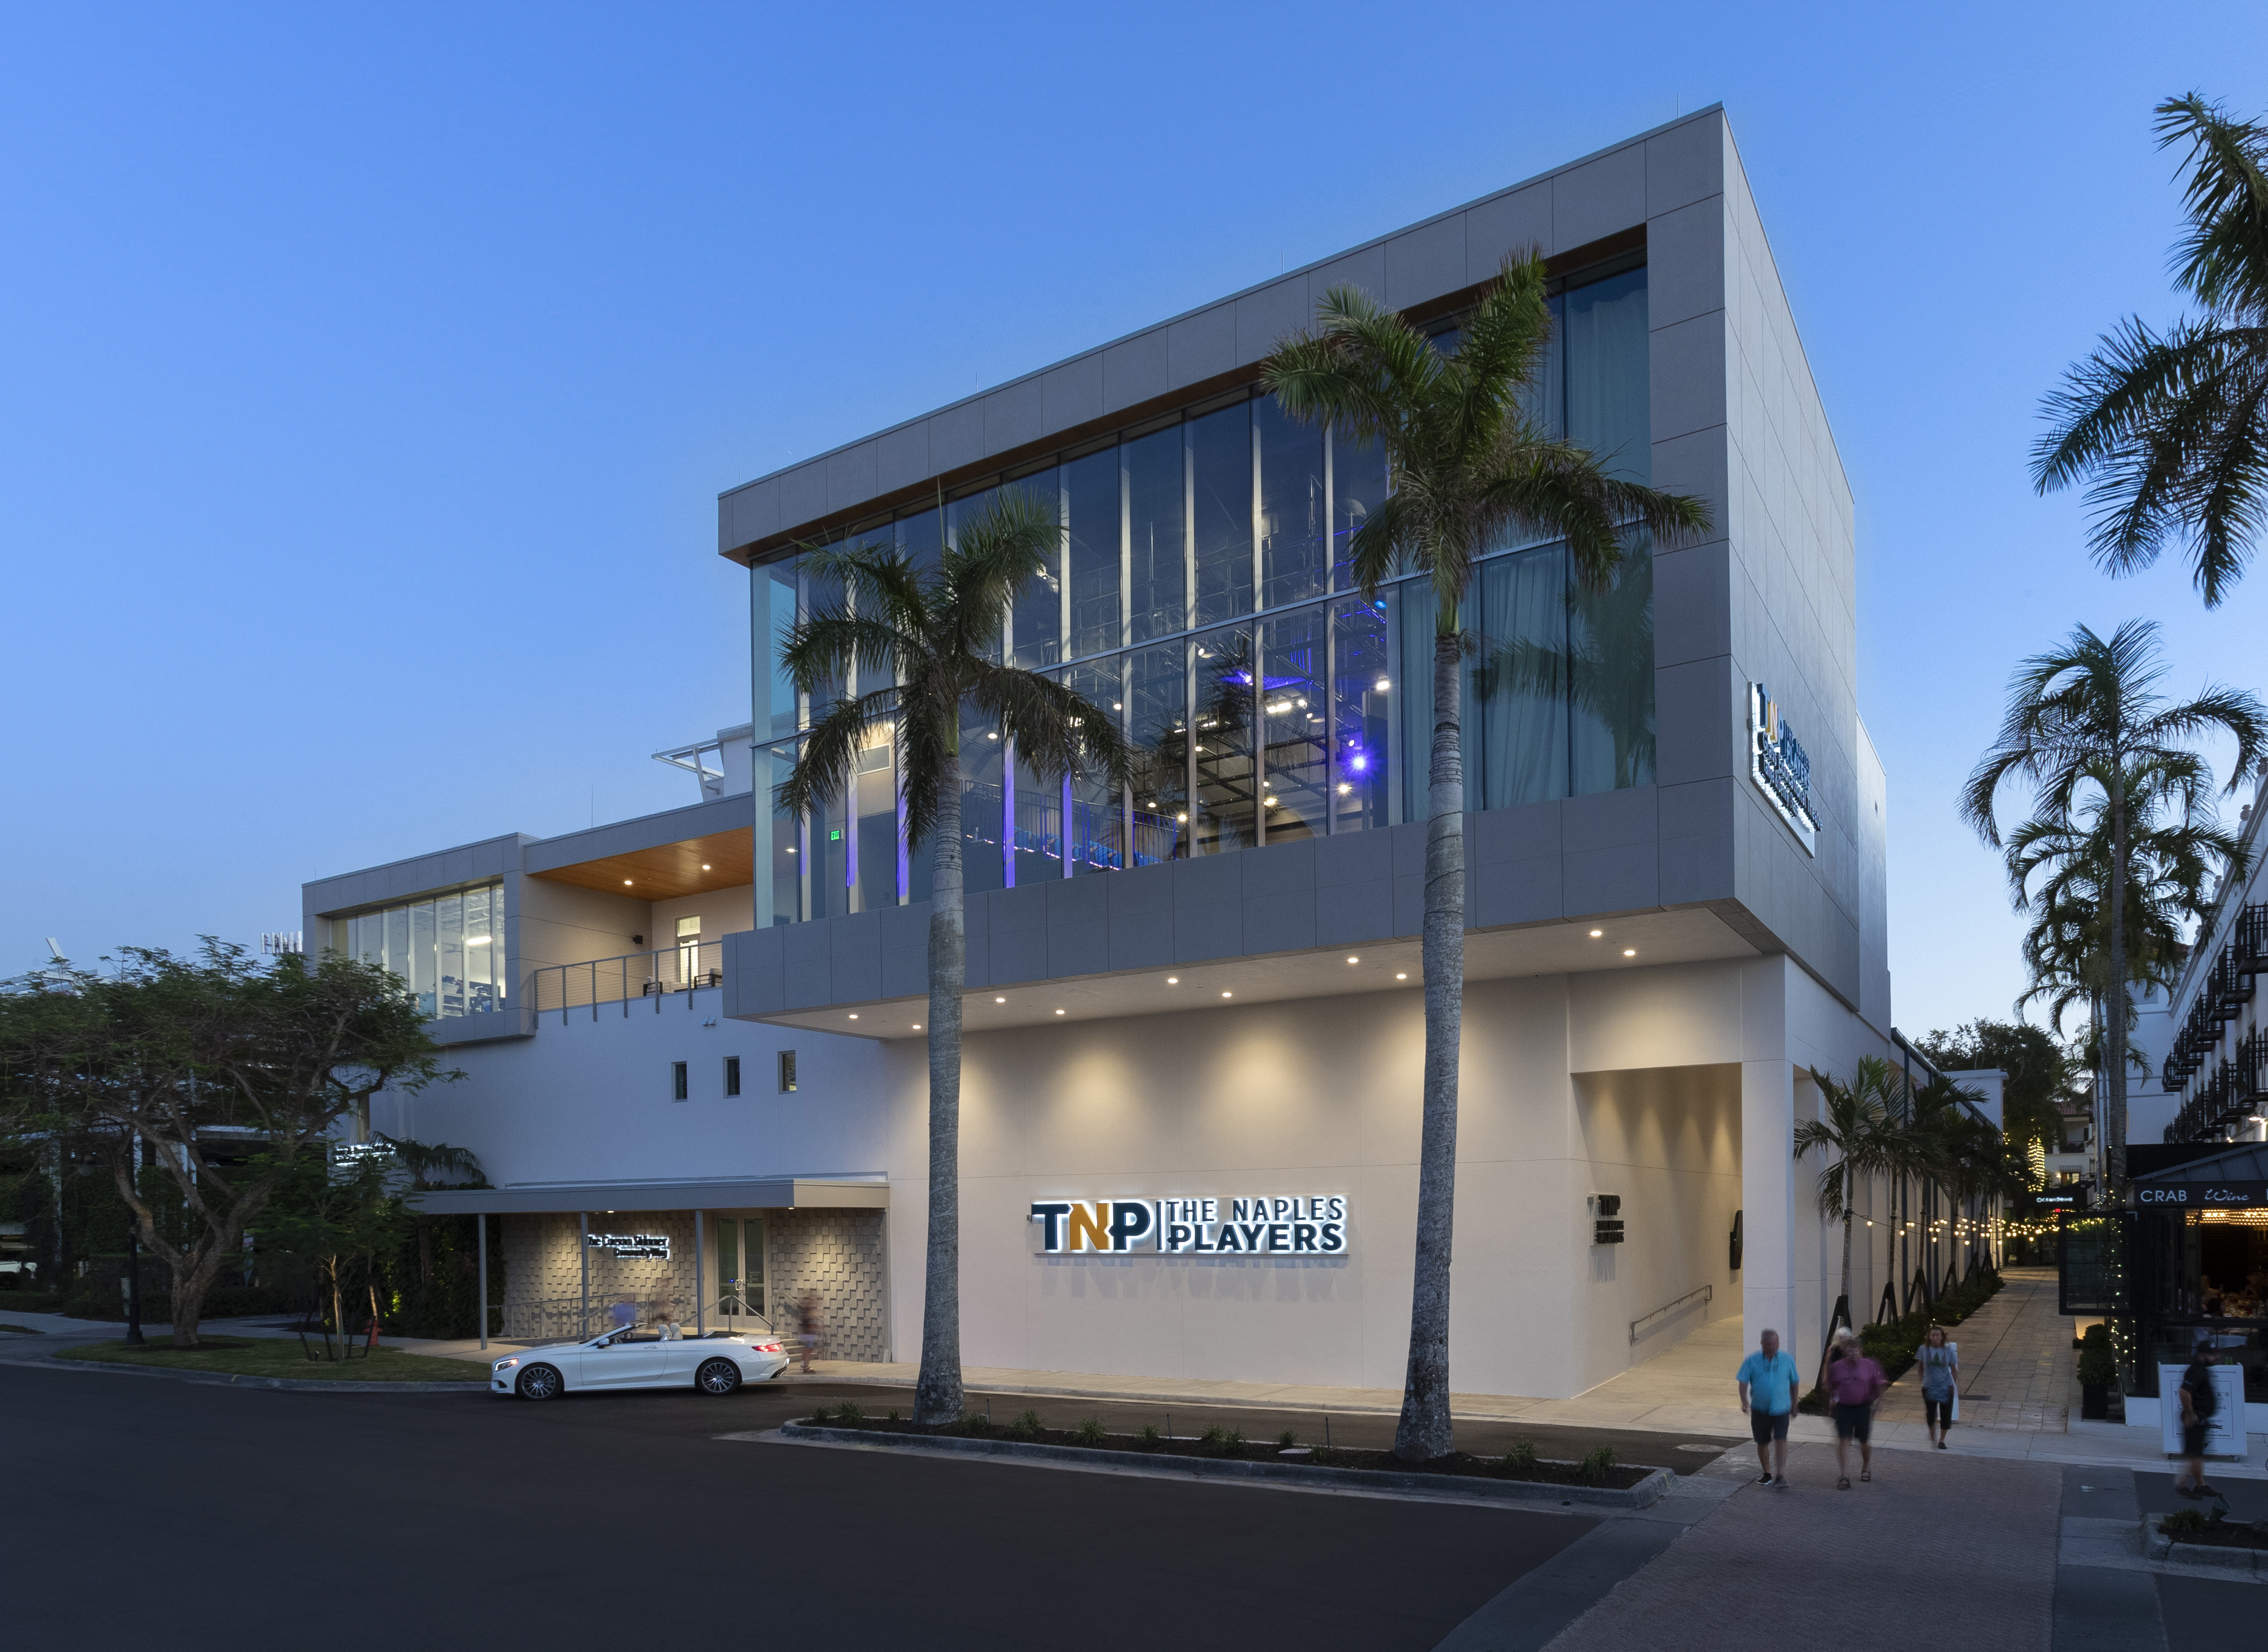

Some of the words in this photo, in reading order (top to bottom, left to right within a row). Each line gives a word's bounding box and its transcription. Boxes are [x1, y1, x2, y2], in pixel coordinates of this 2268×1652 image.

[1598, 1195, 1621, 1215] TNP
[2140, 1190, 2187, 1202] CRAB
[2204, 1188, 2249, 1202] Wine
[1166, 1200, 1215, 1222] THE
[1233, 1198, 1343, 1221] NAPLES
[1032, 1202, 1150, 1250] TNP
[1166, 1223, 1343, 1251] PLAYERS
